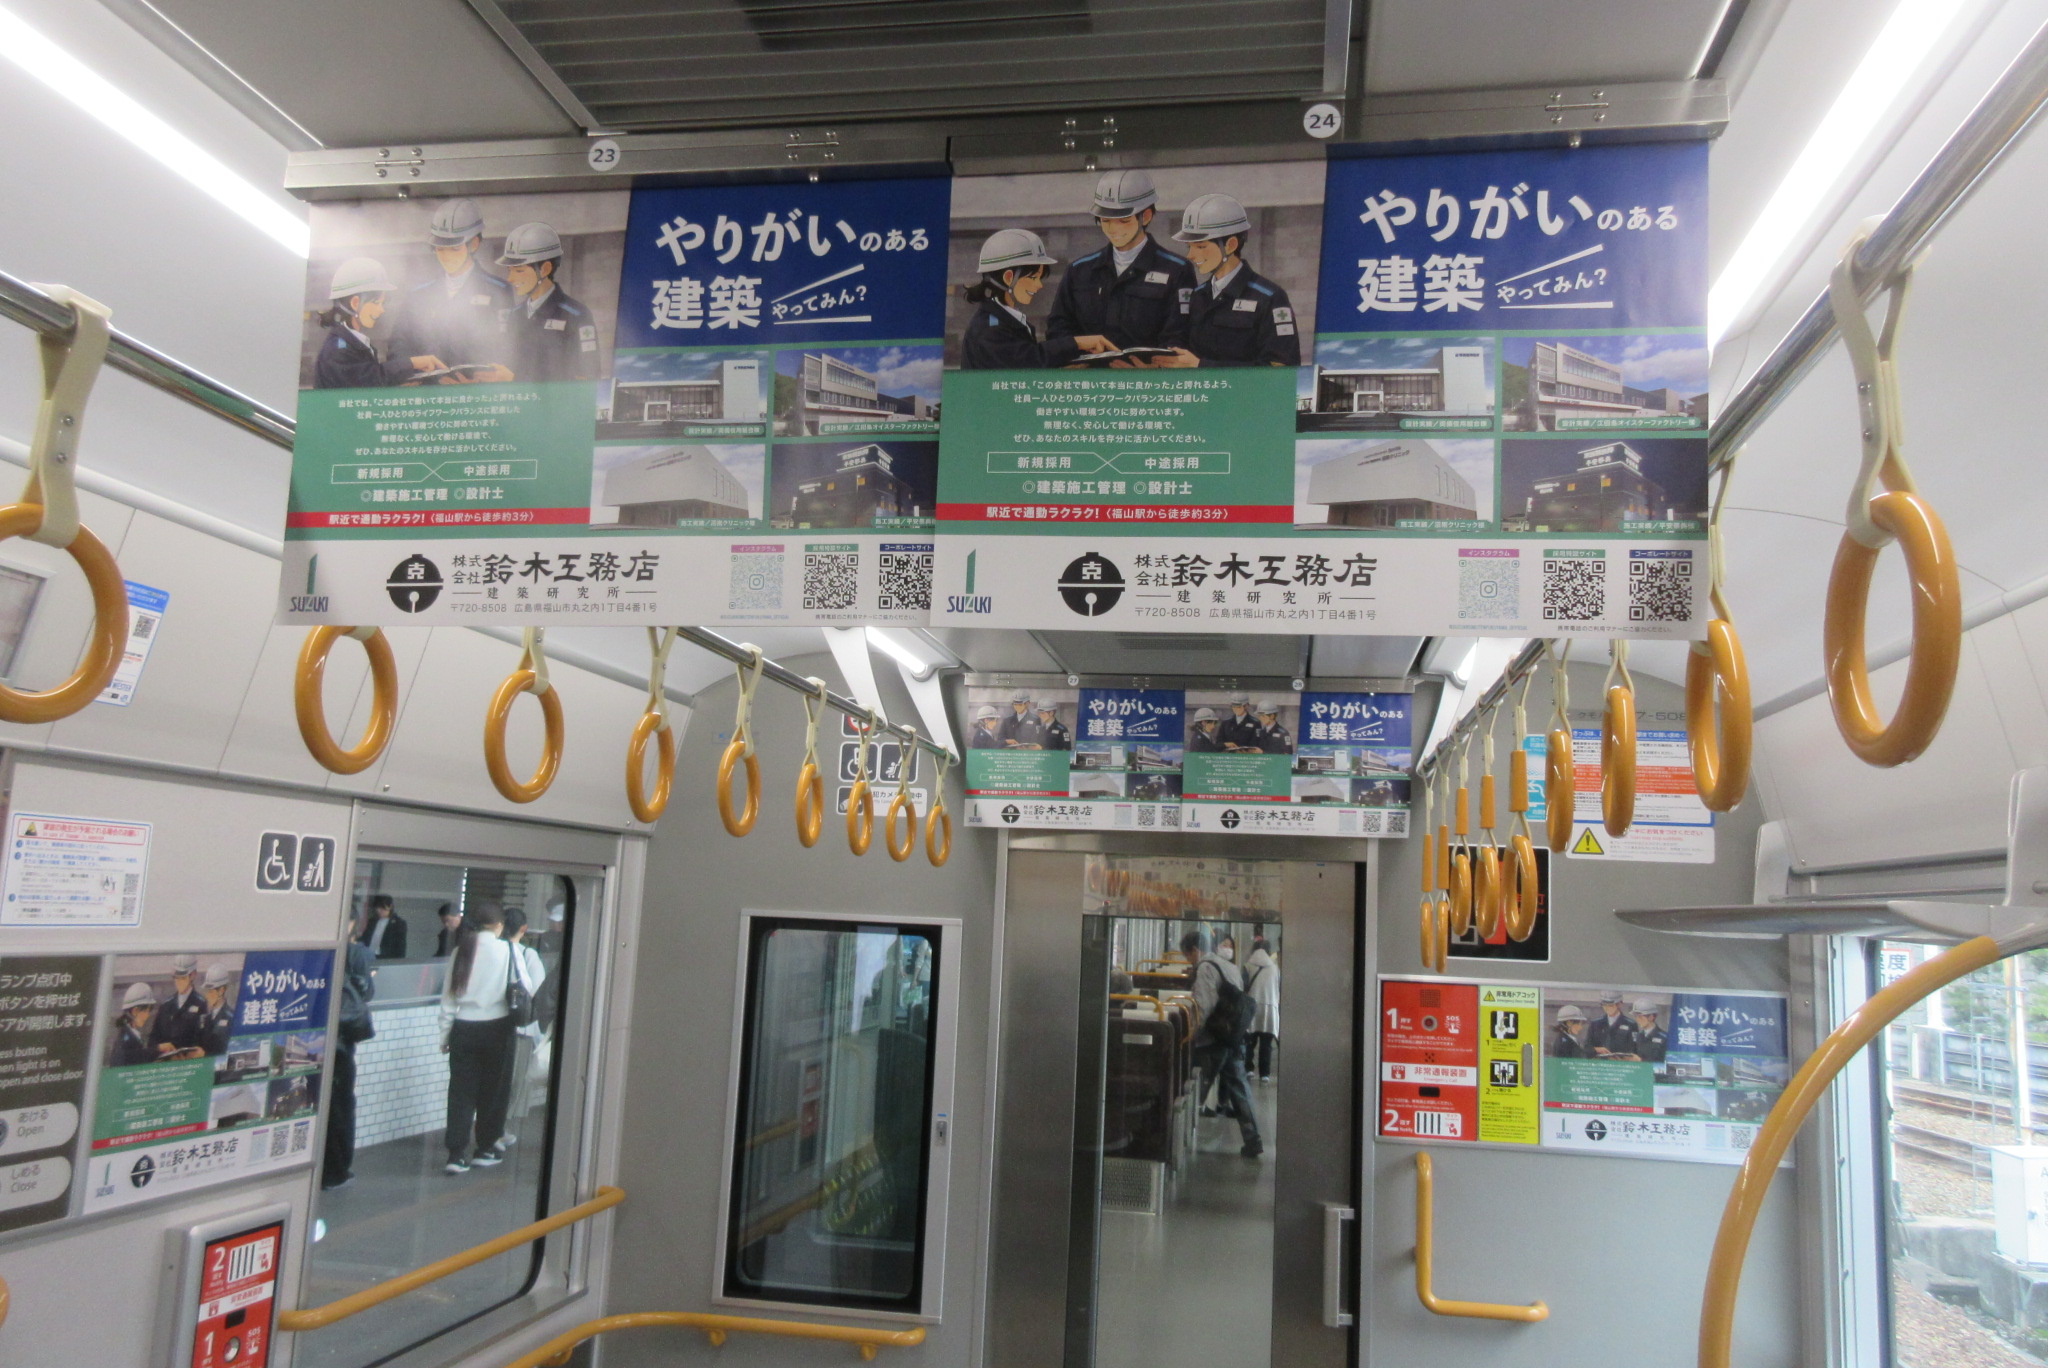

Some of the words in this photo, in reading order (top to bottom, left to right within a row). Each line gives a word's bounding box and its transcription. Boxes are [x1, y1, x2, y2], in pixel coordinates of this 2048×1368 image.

[1309, 113, 1336, 129] 24
[592, 148, 616, 163] 23
[1358, 181, 1679, 244] やりがいのある
[655, 207, 930, 266] やりがいのある
[1356, 253, 1486, 314] 建築
[650, 275, 762, 330] 建築
[1017, 456, 1072, 469] 新規採用
[1144, 456, 1200, 470] 中途採用
[356, 467, 404, 480] 新規採用
[463, 464, 511, 477] 中途採用
[452, 554, 482, 568] 株式
[483, 549, 660, 585] 鈴木工務店
[1134, 553, 1171, 569] 株式
[452, 570, 481, 585] 会社
[1171, 552, 1379, 588] 鈴木工務店
[1134, 571, 1171, 587] 会社
[487, 585, 621, 600] 建築研究所
[1176, 589, 1334, 606] 建築研究所
[289, 596, 329, 613] SUZUKI
[946, 595, 992, 614] SUZUKI
[1208, 608, 1377, 621] 広島県福山市丸之内1丁目4番1号
[1088, 698, 1177, 717] やりがいのある
[1310, 701, 1404, 720] やりがいのある
[1087, 718, 1124, 737] 建築
[1309, 722, 1348, 741] 建築
[246, 968, 326, 995] やりがいのある
[242, 998, 279, 1026] 建築
[1386, 1007, 1398, 1030] 1
[1677, 1006, 1775, 1026] やりがいのある
[1677, 1027, 1718, 1047] 建築
[15, 1046, 47, 1057] button
[16, 1061, 38, 1073] light
[39, 1059, 47, 1068] is
[48, 1059, 61, 1068] on
[1414, 1066, 1467, 1077] 非常通報装置
[22, 1074, 40, 1085] and
[41, 1072, 62, 1083] close
[1485, 1087, 1491, 1095] 2
[19, 1109, 49, 1123] あける
[1383, 1109, 1399, 1132] 2
[17, 1125, 45, 1138] Open
[11, 1164, 41, 1180] しめる
[10, 1181, 37, 1193] Close
[212, 1246, 226, 1272] 2
[247, 1326, 261, 1338] SOS
[204, 1331, 215, 1356] 1
